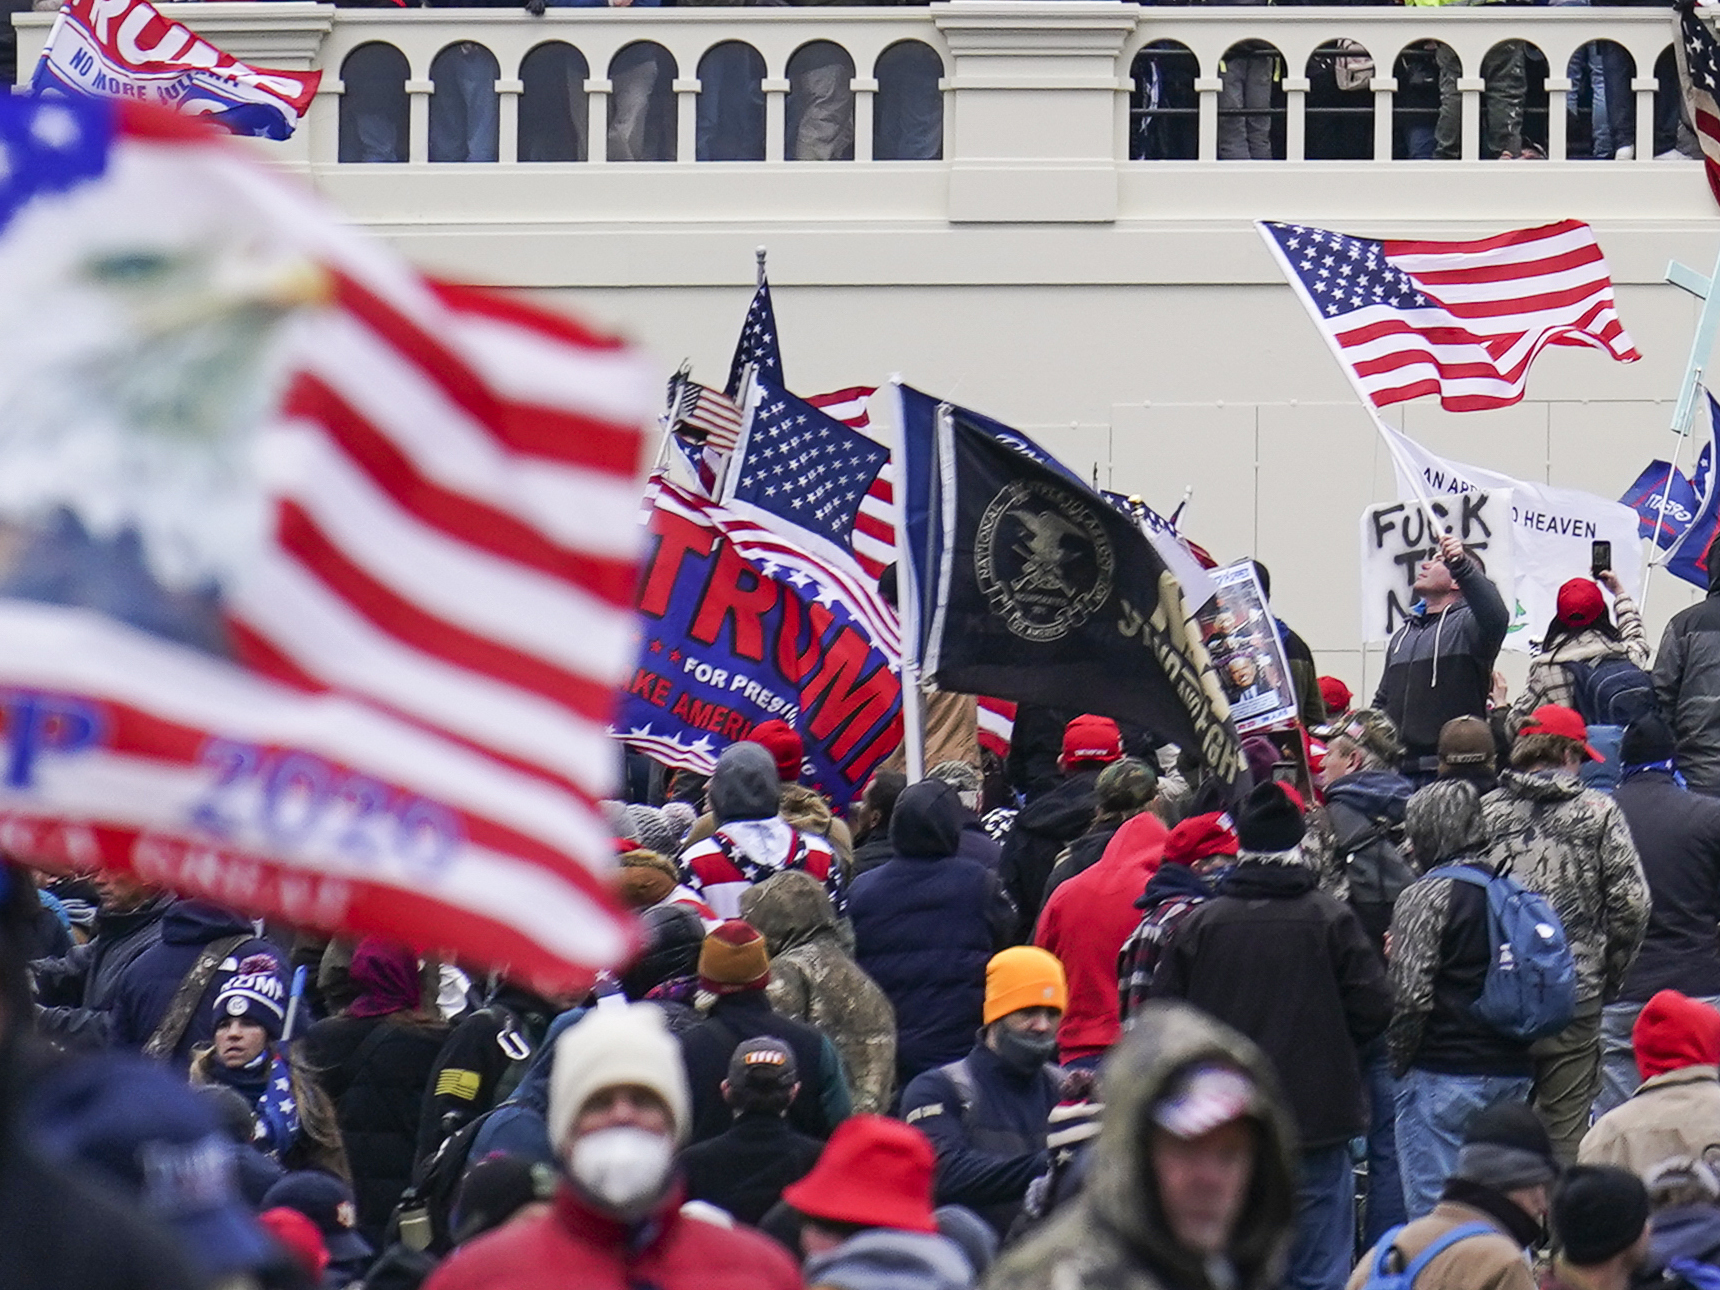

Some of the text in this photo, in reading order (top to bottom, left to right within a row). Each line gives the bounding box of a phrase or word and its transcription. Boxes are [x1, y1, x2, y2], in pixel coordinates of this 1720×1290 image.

[69, 47, 94, 77] NO
[91, 69, 146, 101] MORE
[1525, 510, 1597, 540] HEAVEN
[684, 657, 729, 689] FOR
[191, 734, 466, 875] 2020
